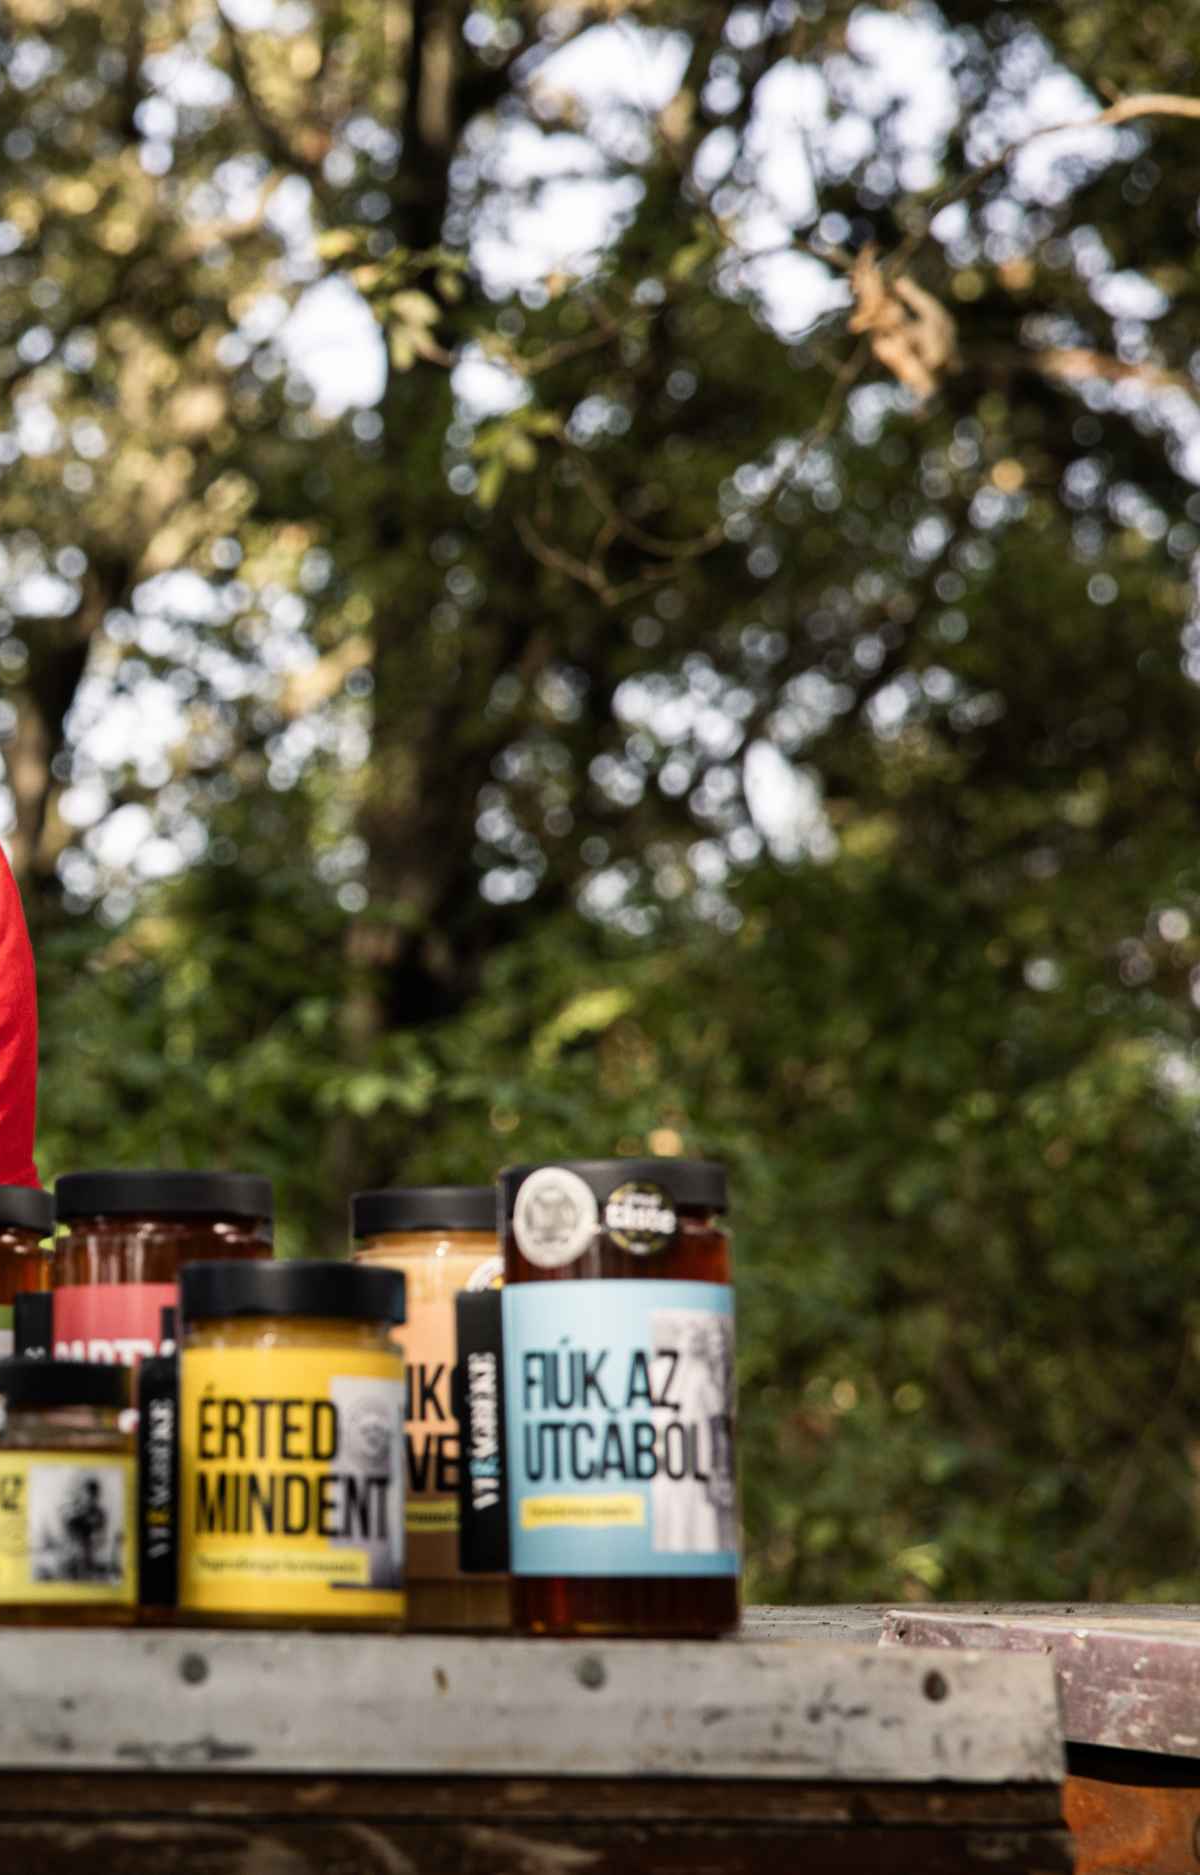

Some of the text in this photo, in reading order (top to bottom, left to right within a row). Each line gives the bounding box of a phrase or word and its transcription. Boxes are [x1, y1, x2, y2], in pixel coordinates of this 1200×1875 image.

[522, 1334, 681, 1412] FIÚK AZ
[197, 1384, 339, 1461] ÉRTED
[522, 1407, 710, 1483] UTCÁBÓL
[195, 1472, 391, 1541] MINDENT
